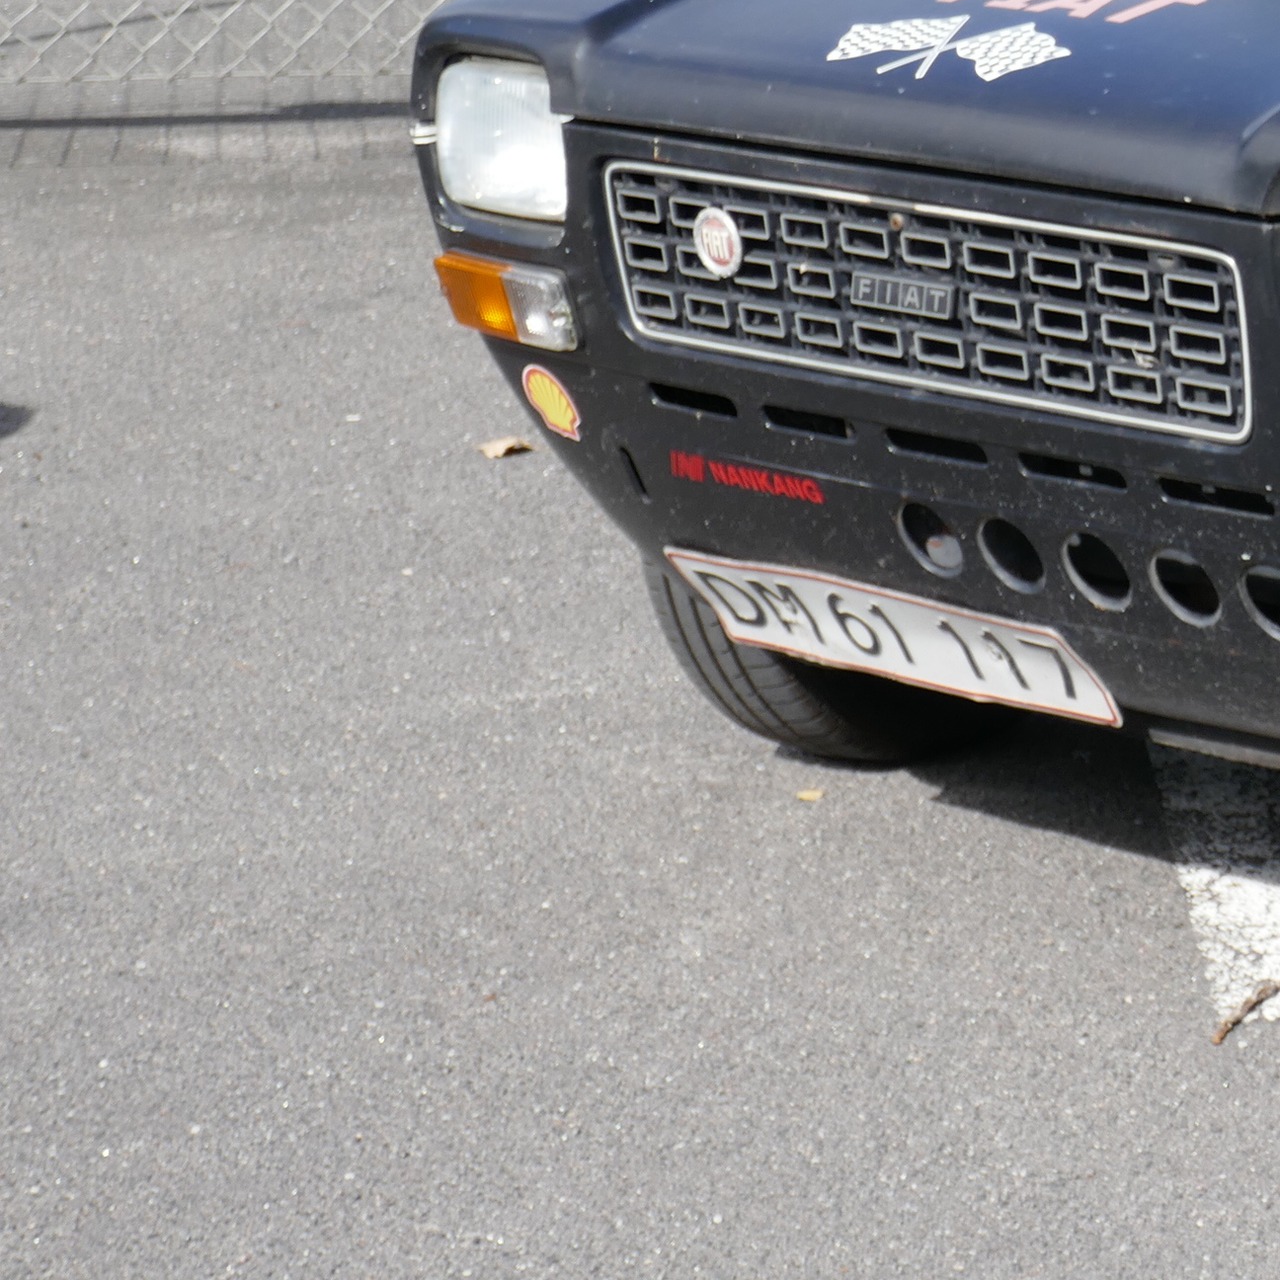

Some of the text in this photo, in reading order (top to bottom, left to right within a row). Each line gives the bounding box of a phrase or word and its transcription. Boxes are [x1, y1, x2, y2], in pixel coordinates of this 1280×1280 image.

[702, 227, 731, 260] FIAT
[858, 278, 946, 313] FIAT
[708, 460, 824, 504] NANKANG
[696, 570, 1078, 700] DM 61 117
